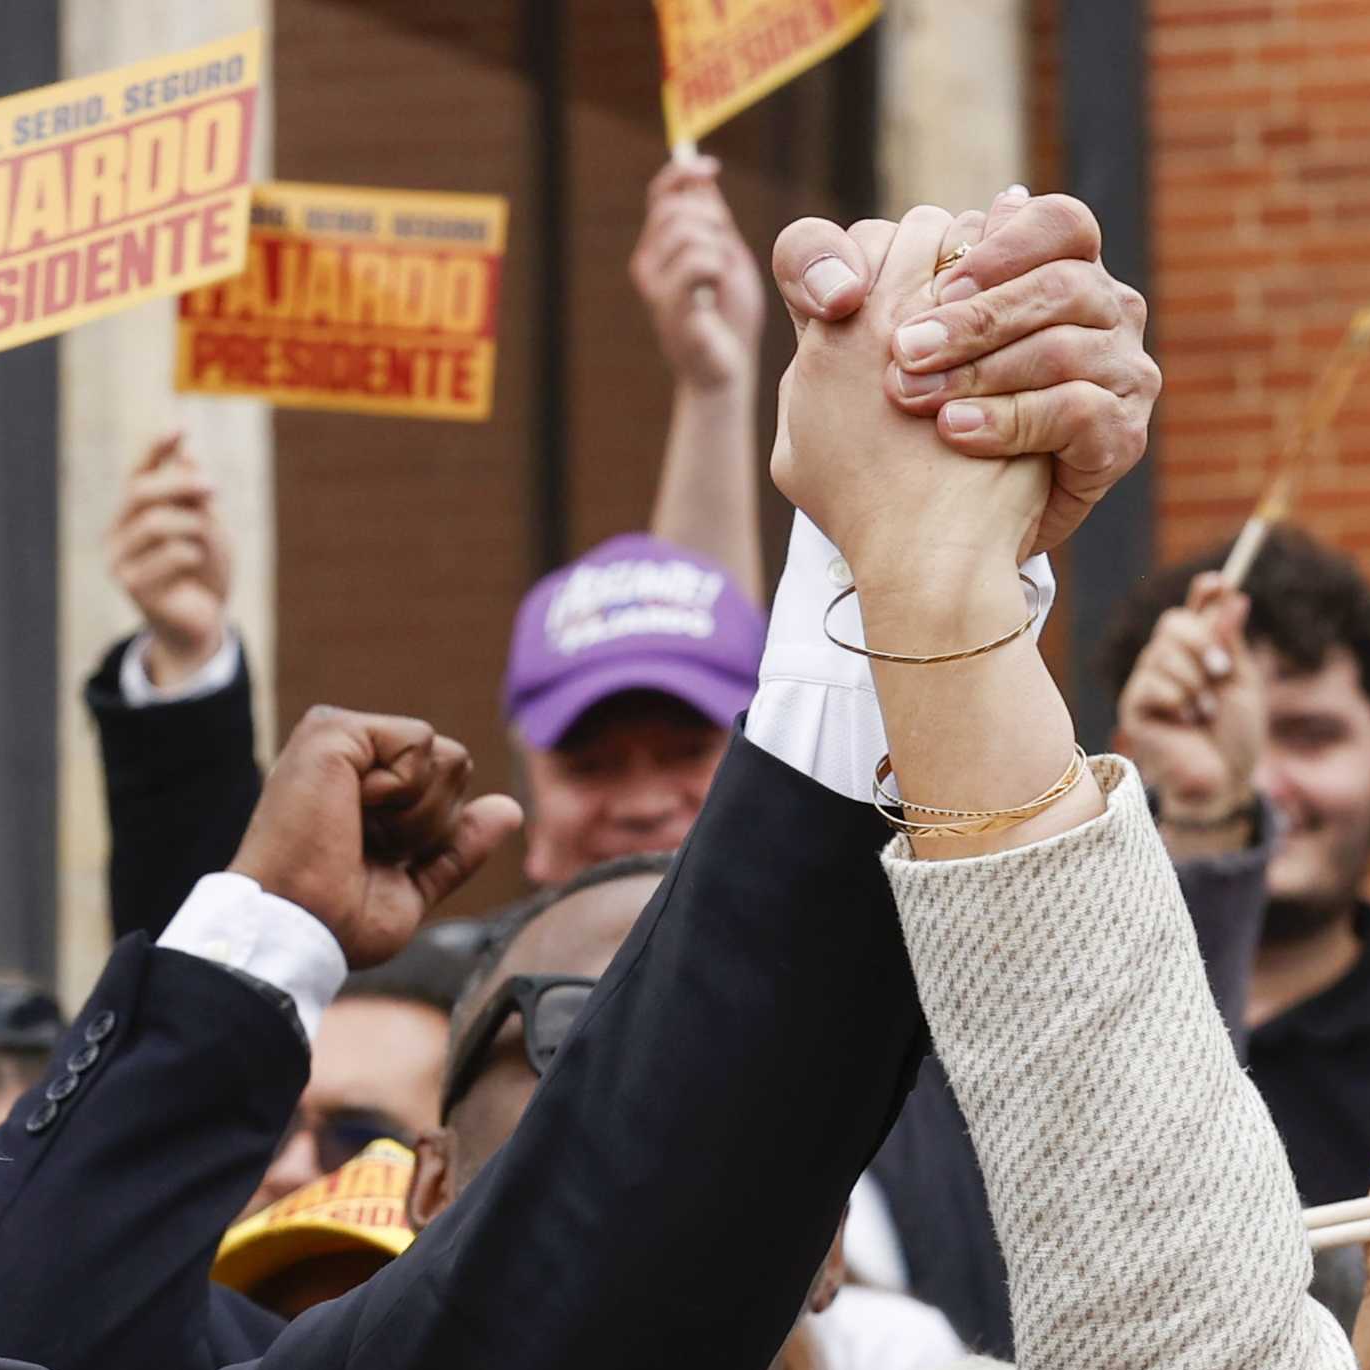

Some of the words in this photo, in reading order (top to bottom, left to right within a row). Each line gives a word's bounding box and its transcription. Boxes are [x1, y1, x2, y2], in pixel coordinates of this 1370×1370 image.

[13, 96, 113, 146] SERIO.
[124, 54, 244, 116] SEGURO
[192, 332, 476, 404] PRESIDENTE
